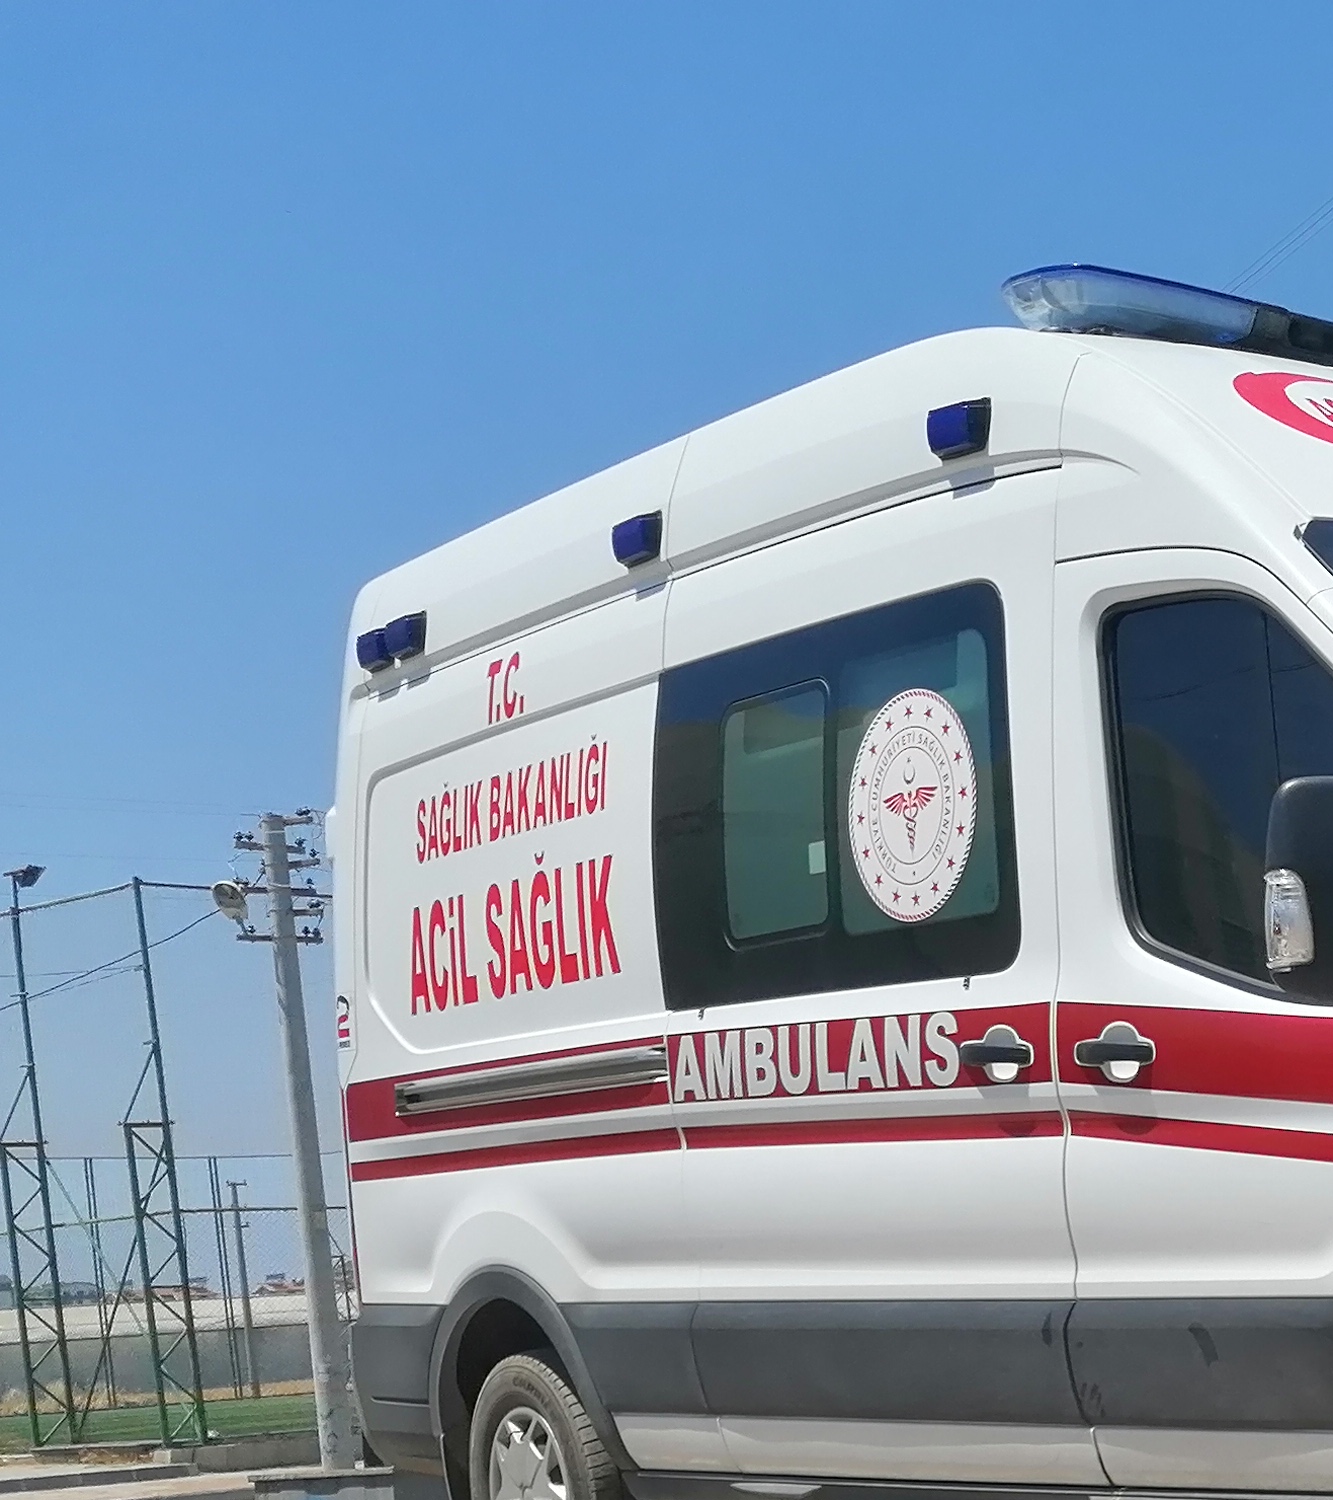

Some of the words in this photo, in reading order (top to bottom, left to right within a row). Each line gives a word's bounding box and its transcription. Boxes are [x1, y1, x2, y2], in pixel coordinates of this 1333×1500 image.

[487, 651, 525, 726] T.C.
[416, 782, 483, 865] SAĞLIK
[489, 734, 608, 843] BAKANLIĞI
[485, 850, 623, 1000] SAĞLIK
[673, 1010, 961, 1102] AMBULANS
